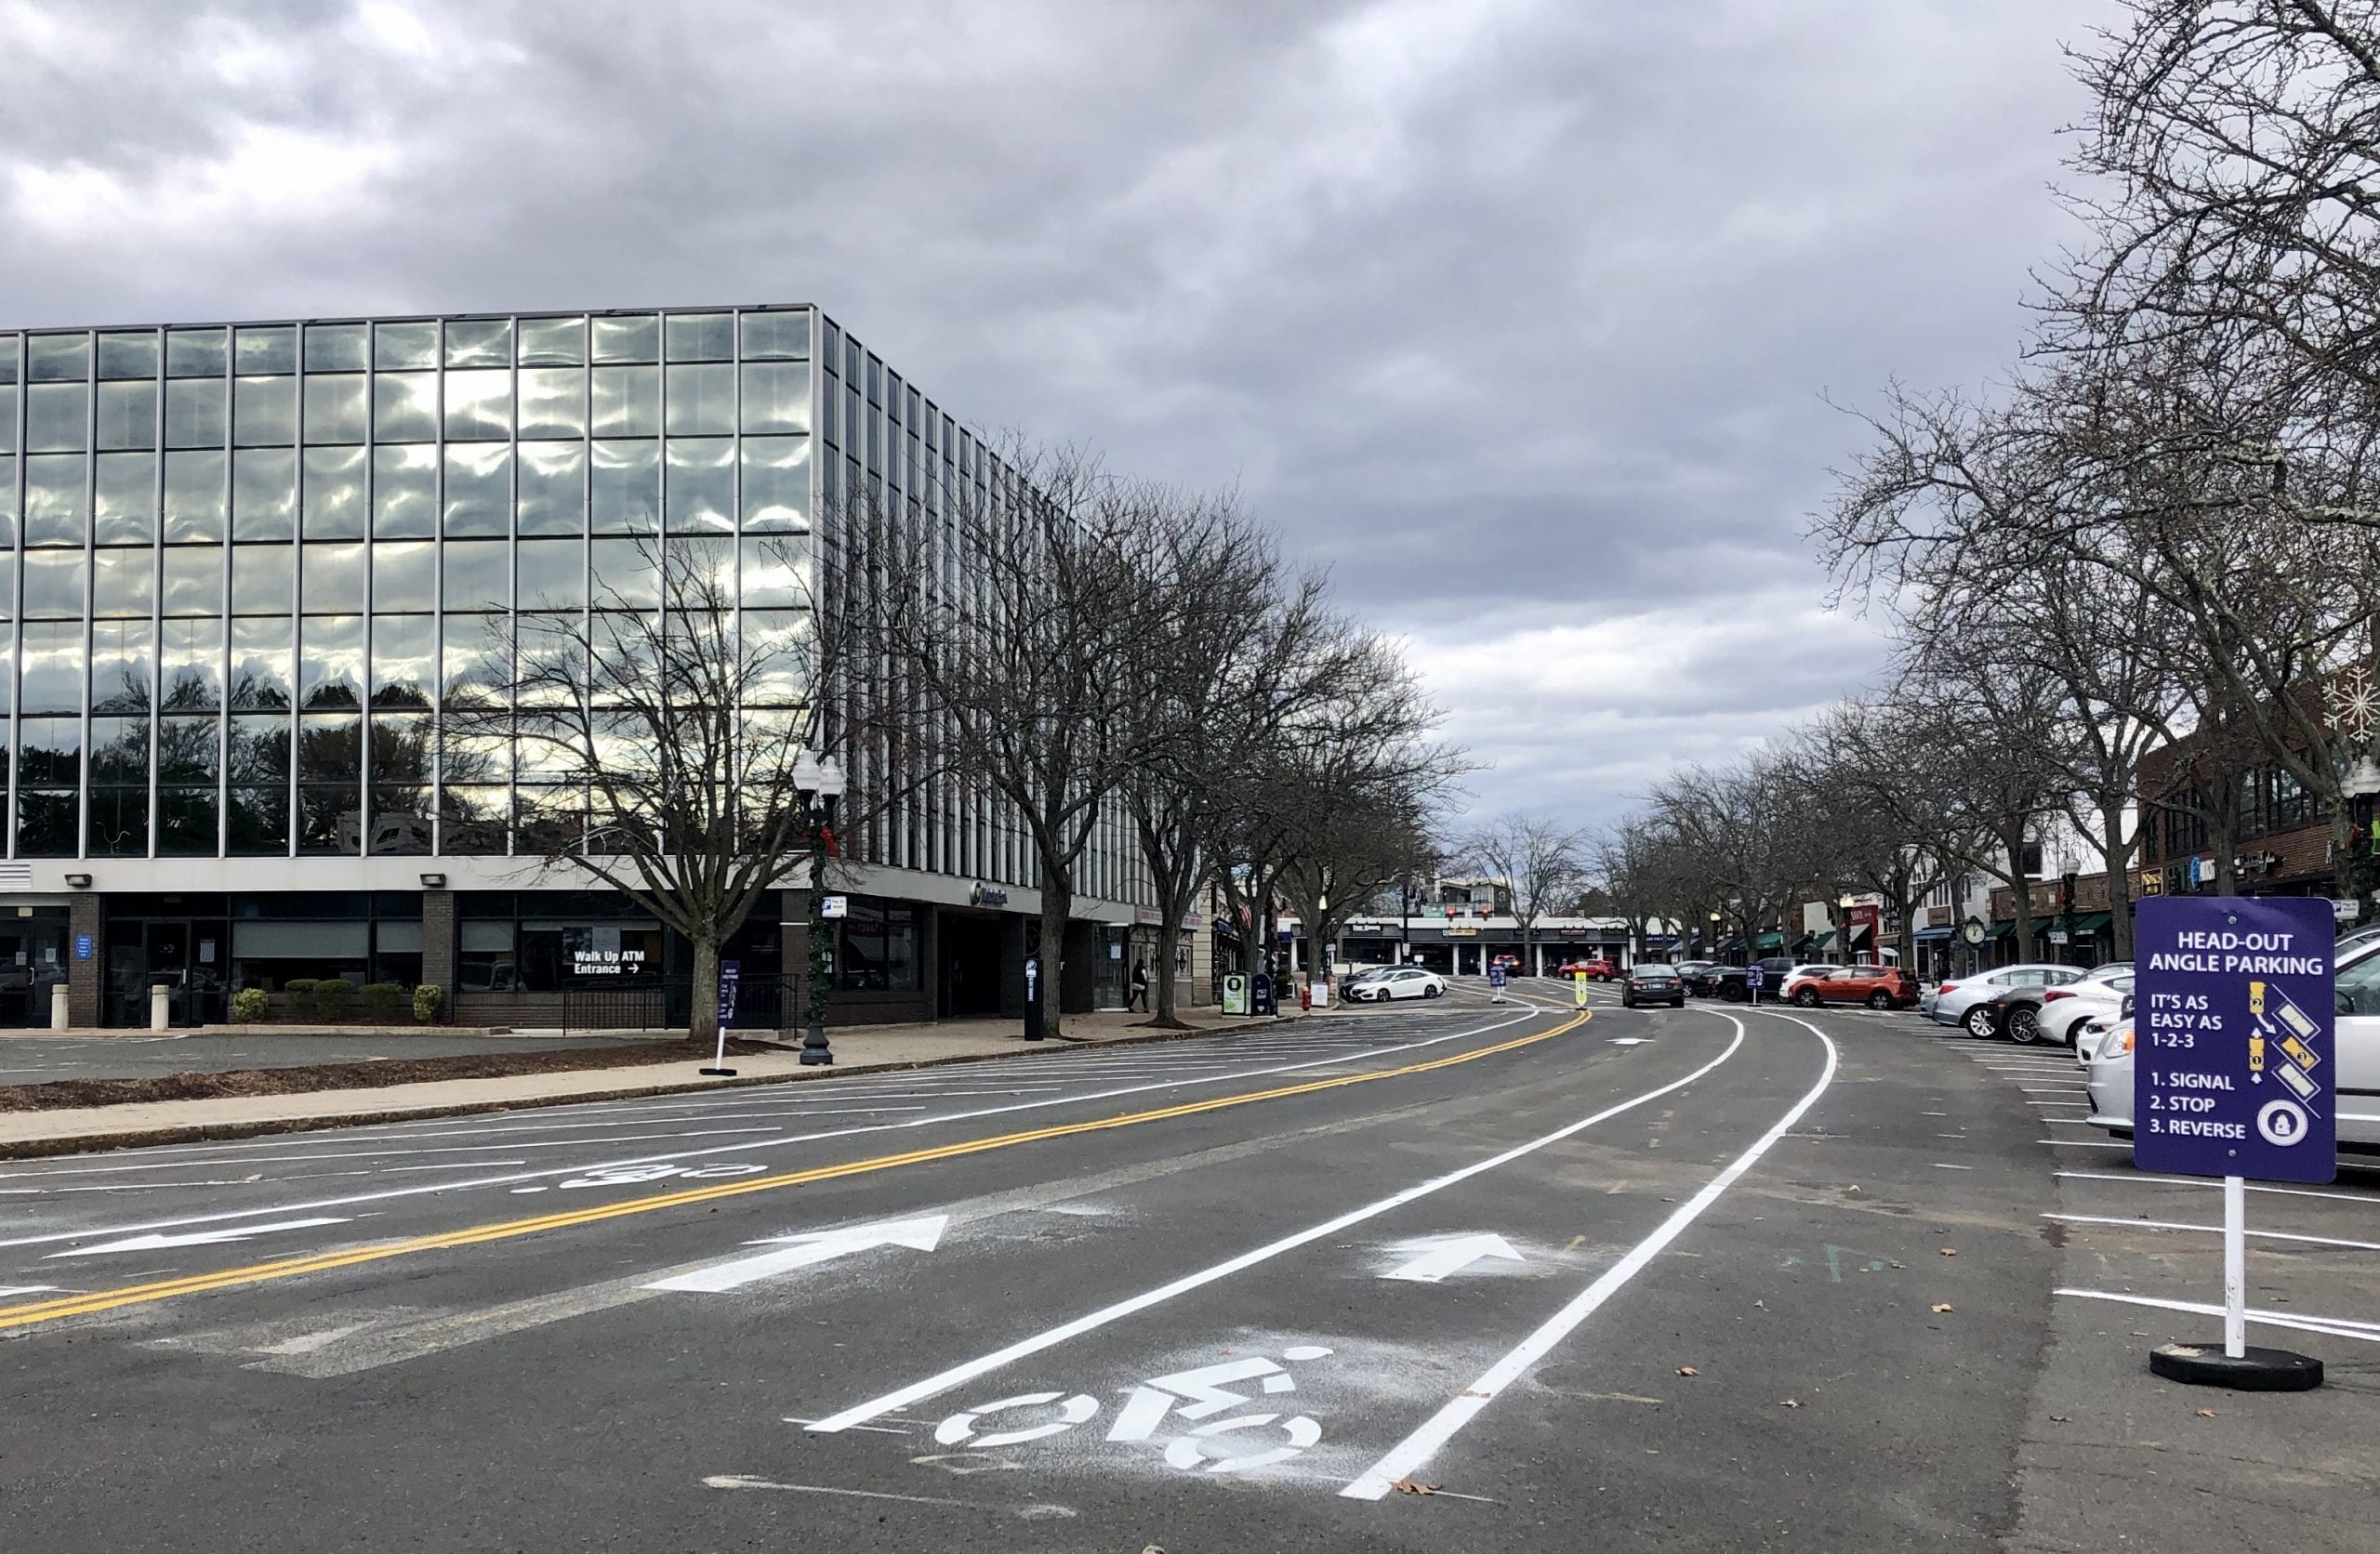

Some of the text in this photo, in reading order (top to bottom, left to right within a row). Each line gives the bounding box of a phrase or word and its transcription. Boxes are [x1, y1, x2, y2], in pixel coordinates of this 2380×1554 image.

[2178, 931, 2294, 951] HEAD-OUT
[575, 951, 644, 964] Walk Up ATM
[2149, 953, 2323, 975] ANGLE PARKING
[574, 963, 621, 974] Entrance
[2150, 994, 2209, 1010] IT'S AS
[2150, 1012, 2223, 1031] EASY AS
[2151, 1032, 2195, 1048] 1-2-3
[2151, 1072, 2236, 1091] 1. SIGNAL
[2150, 1096, 2215, 1113] 2. STOP
[2150, 1119, 2165, 1134] 3.
[2169, 1119, 2246, 1139] REVERSE
